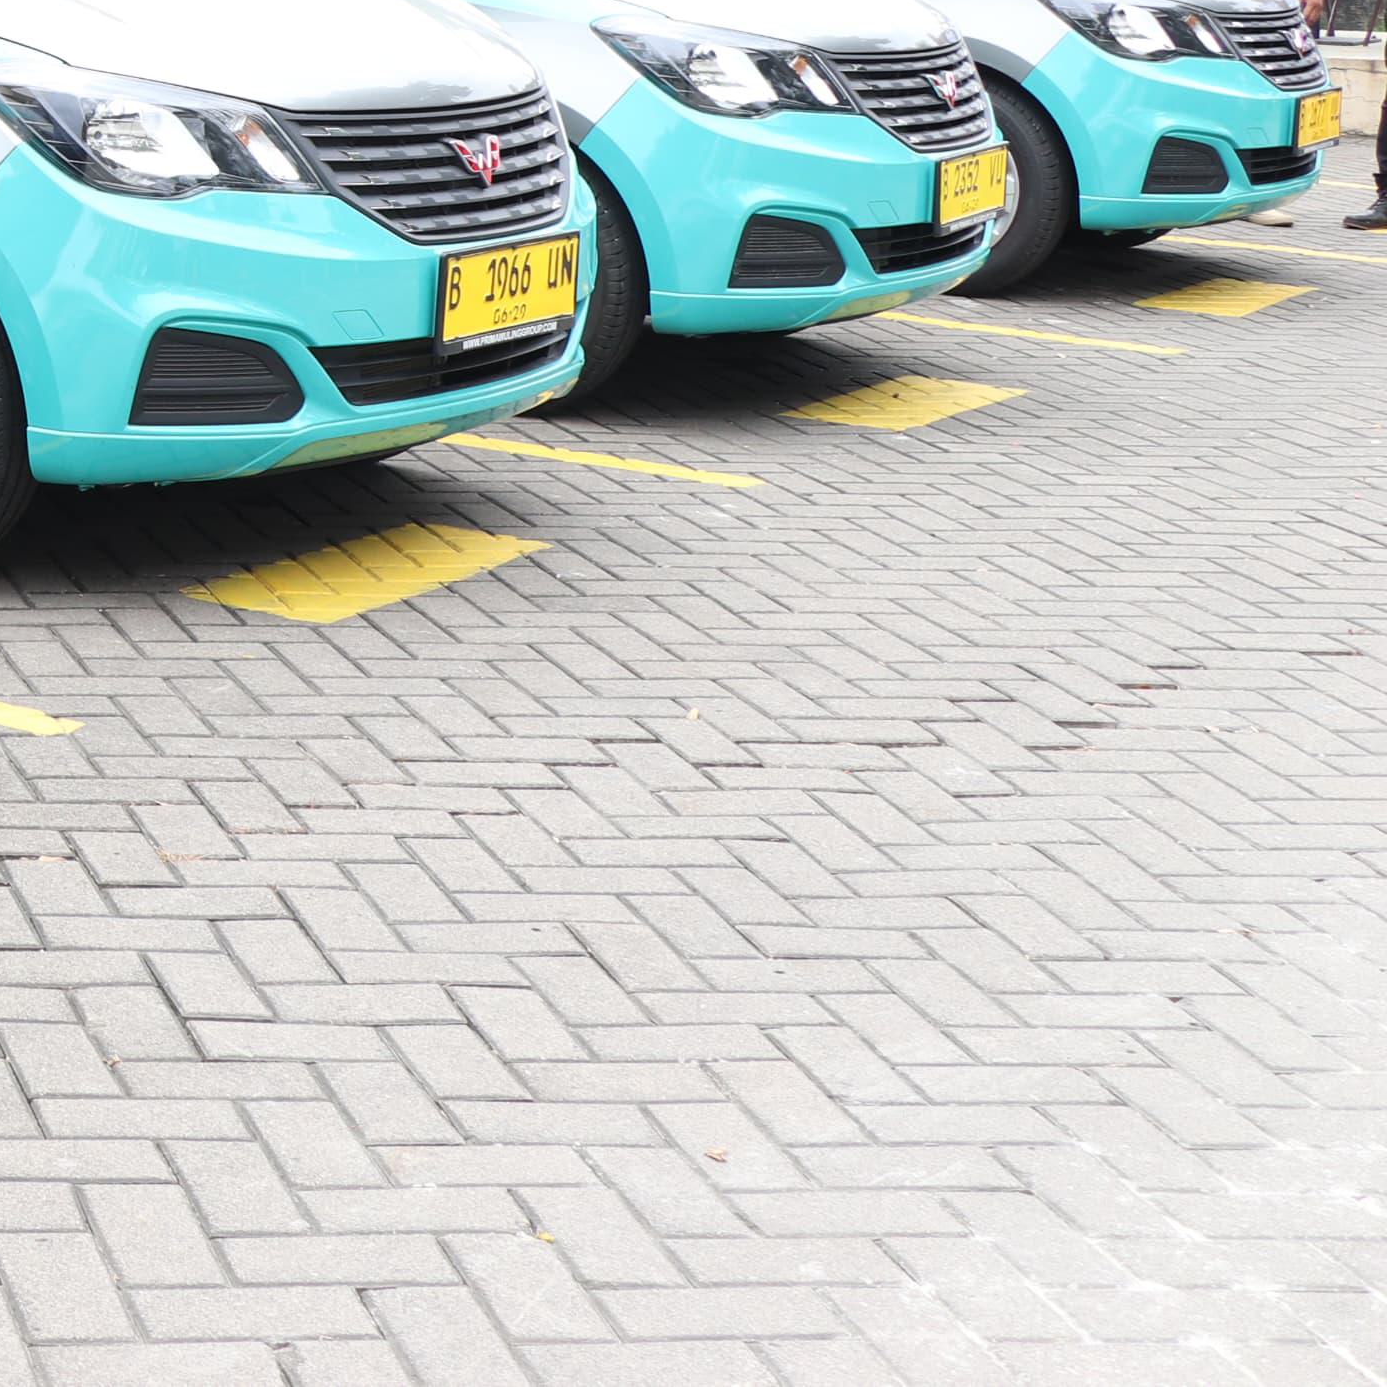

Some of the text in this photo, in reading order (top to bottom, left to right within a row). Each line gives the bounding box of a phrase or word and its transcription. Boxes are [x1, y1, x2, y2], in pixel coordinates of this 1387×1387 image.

[449, 243, 574, 311] B 1966 UN
